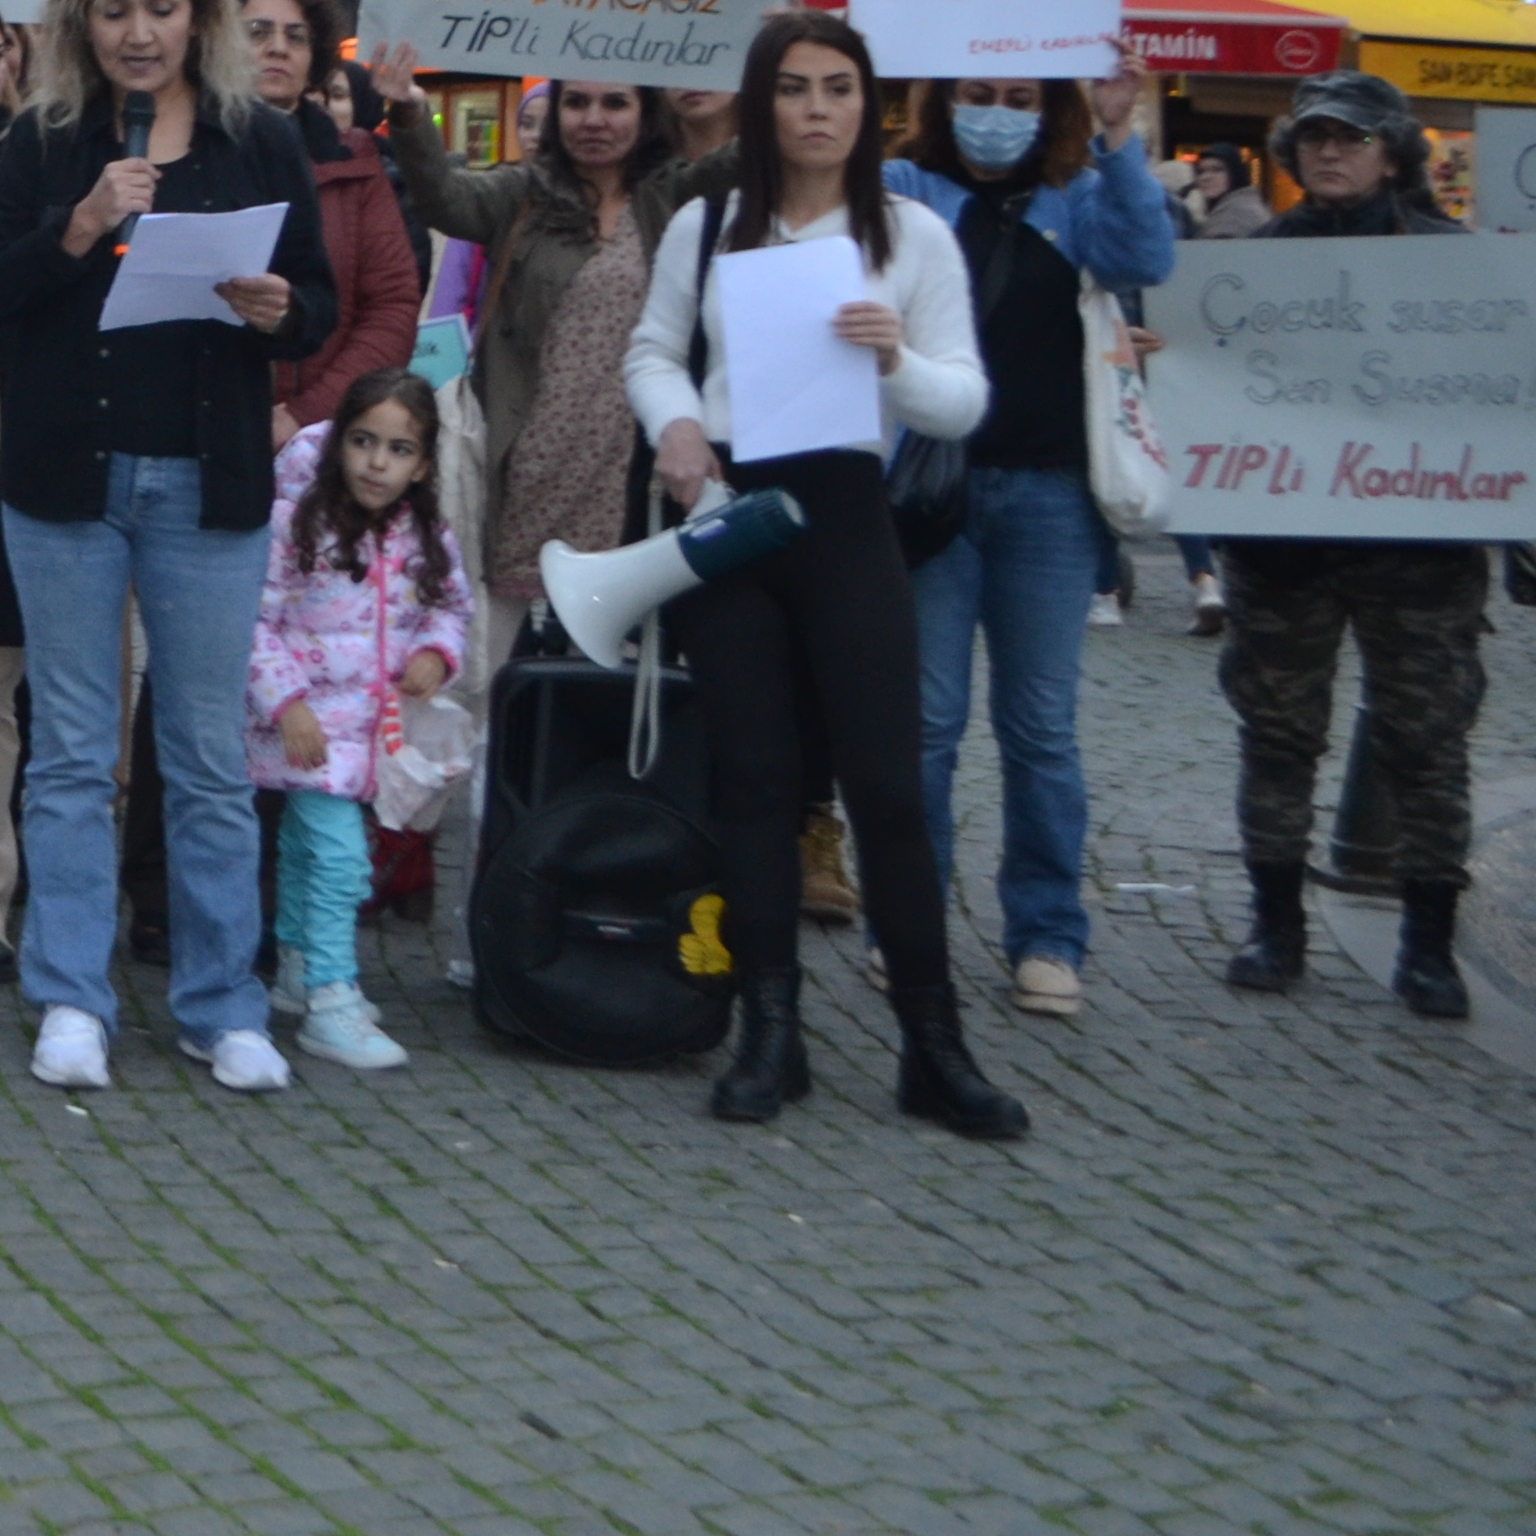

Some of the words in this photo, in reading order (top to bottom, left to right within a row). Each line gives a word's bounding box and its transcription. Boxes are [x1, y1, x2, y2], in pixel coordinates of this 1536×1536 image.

[560, 18, 732, 65] Kadınlar
[1124, 27, 1217, 61] İTAMİN
[1200, 269, 1366, 348] Çocuk
[1244, 349, 1330, 406] Sen
[1330, 440, 1527, 502] Kadınlar
